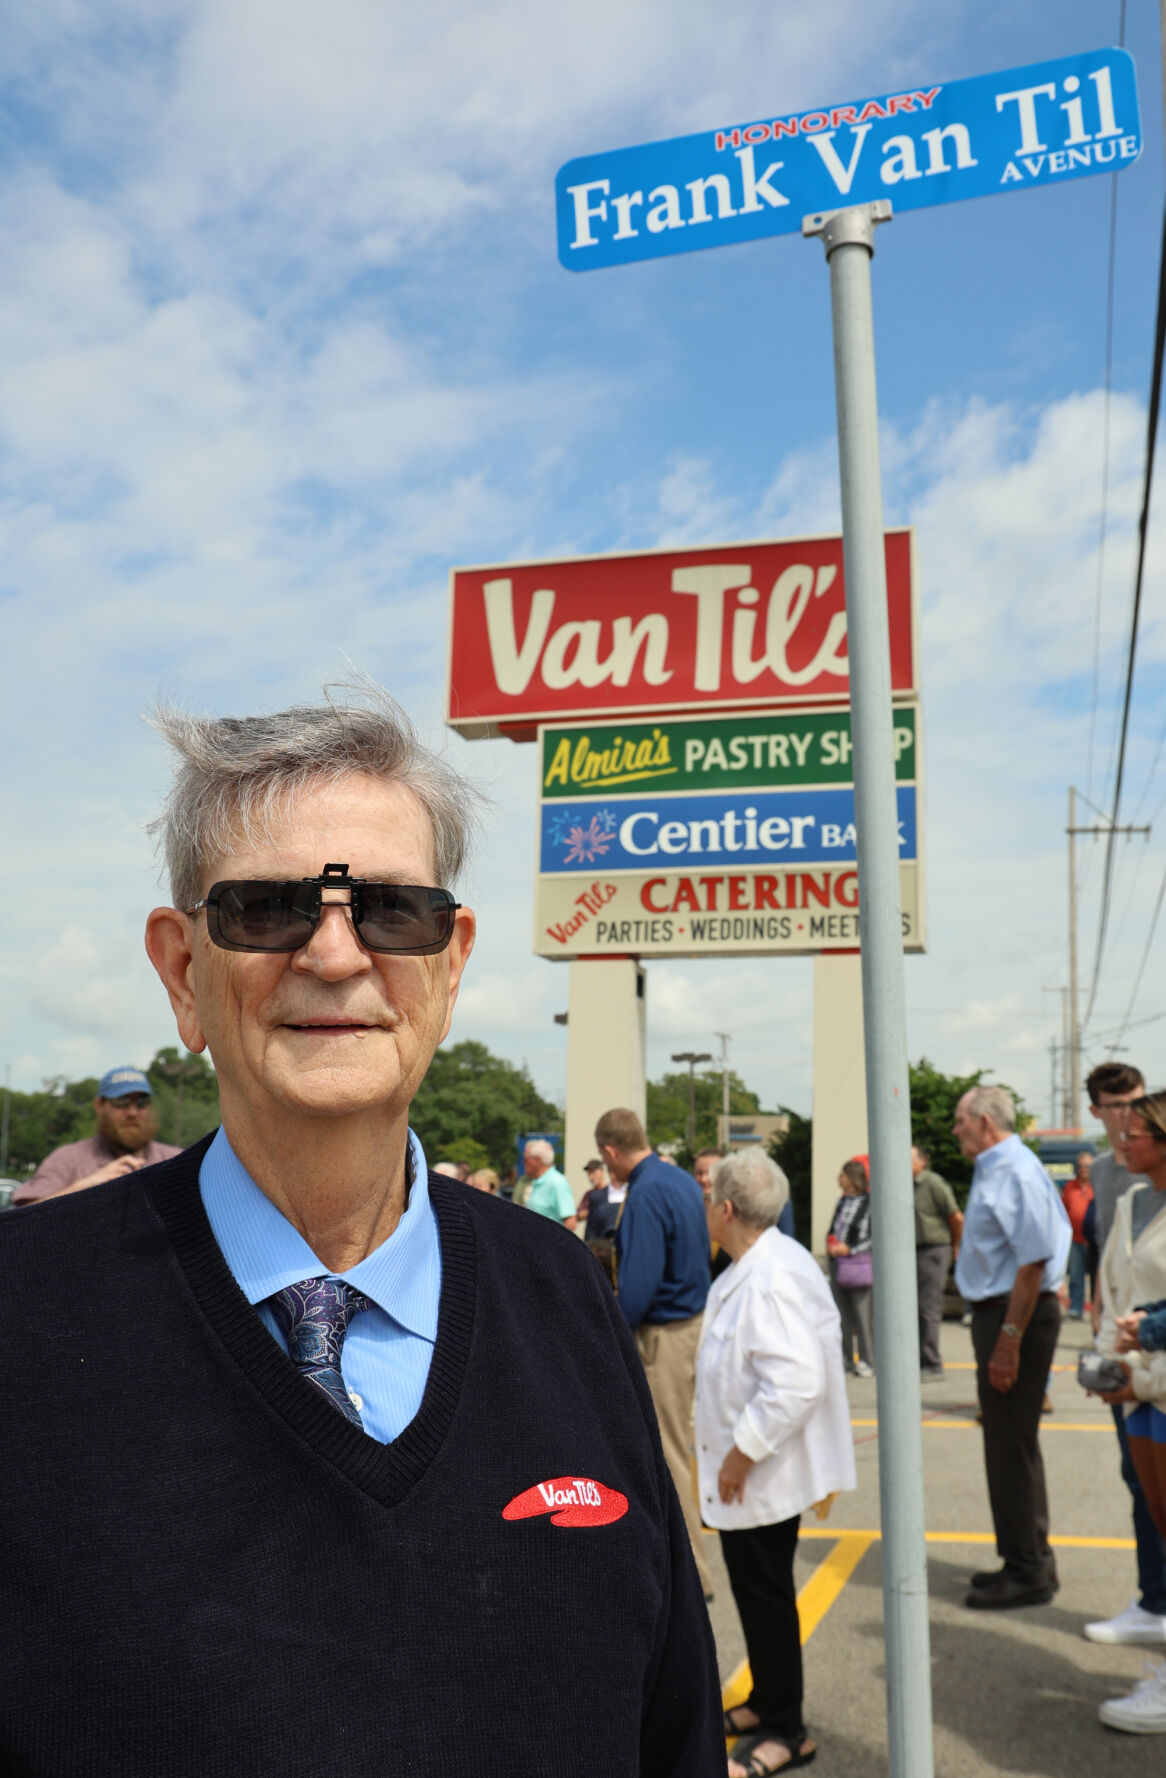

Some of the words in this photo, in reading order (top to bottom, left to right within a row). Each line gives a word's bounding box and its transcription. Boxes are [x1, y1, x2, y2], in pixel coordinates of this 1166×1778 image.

[715, 87, 941, 151] HONORARY
[567, 145, 789, 249] Frank
[806, 123, 978, 194] Van
[996, 66, 1124, 157] Til
[1000, 135, 1138, 184] AVENUE
[483, 578, 674, 695] Van
[545, 728, 672, 787] Almira's
[685, 732, 814, 772] PASTRY
[820, 727, 913, 765] SHP
[619, 807, 815, 855] Centier
[640, 871, 858, 914] CATERING
[546, 910, 589, 945] Van
[596, 919, 674, 944] PARTIES
[690, 913, 792, 941] WEDDINGS
[809, 913, 911, 938] MEETS
[537, 1483, 578, 1507] Van
[572, 1481, 601, 1507] Til's
